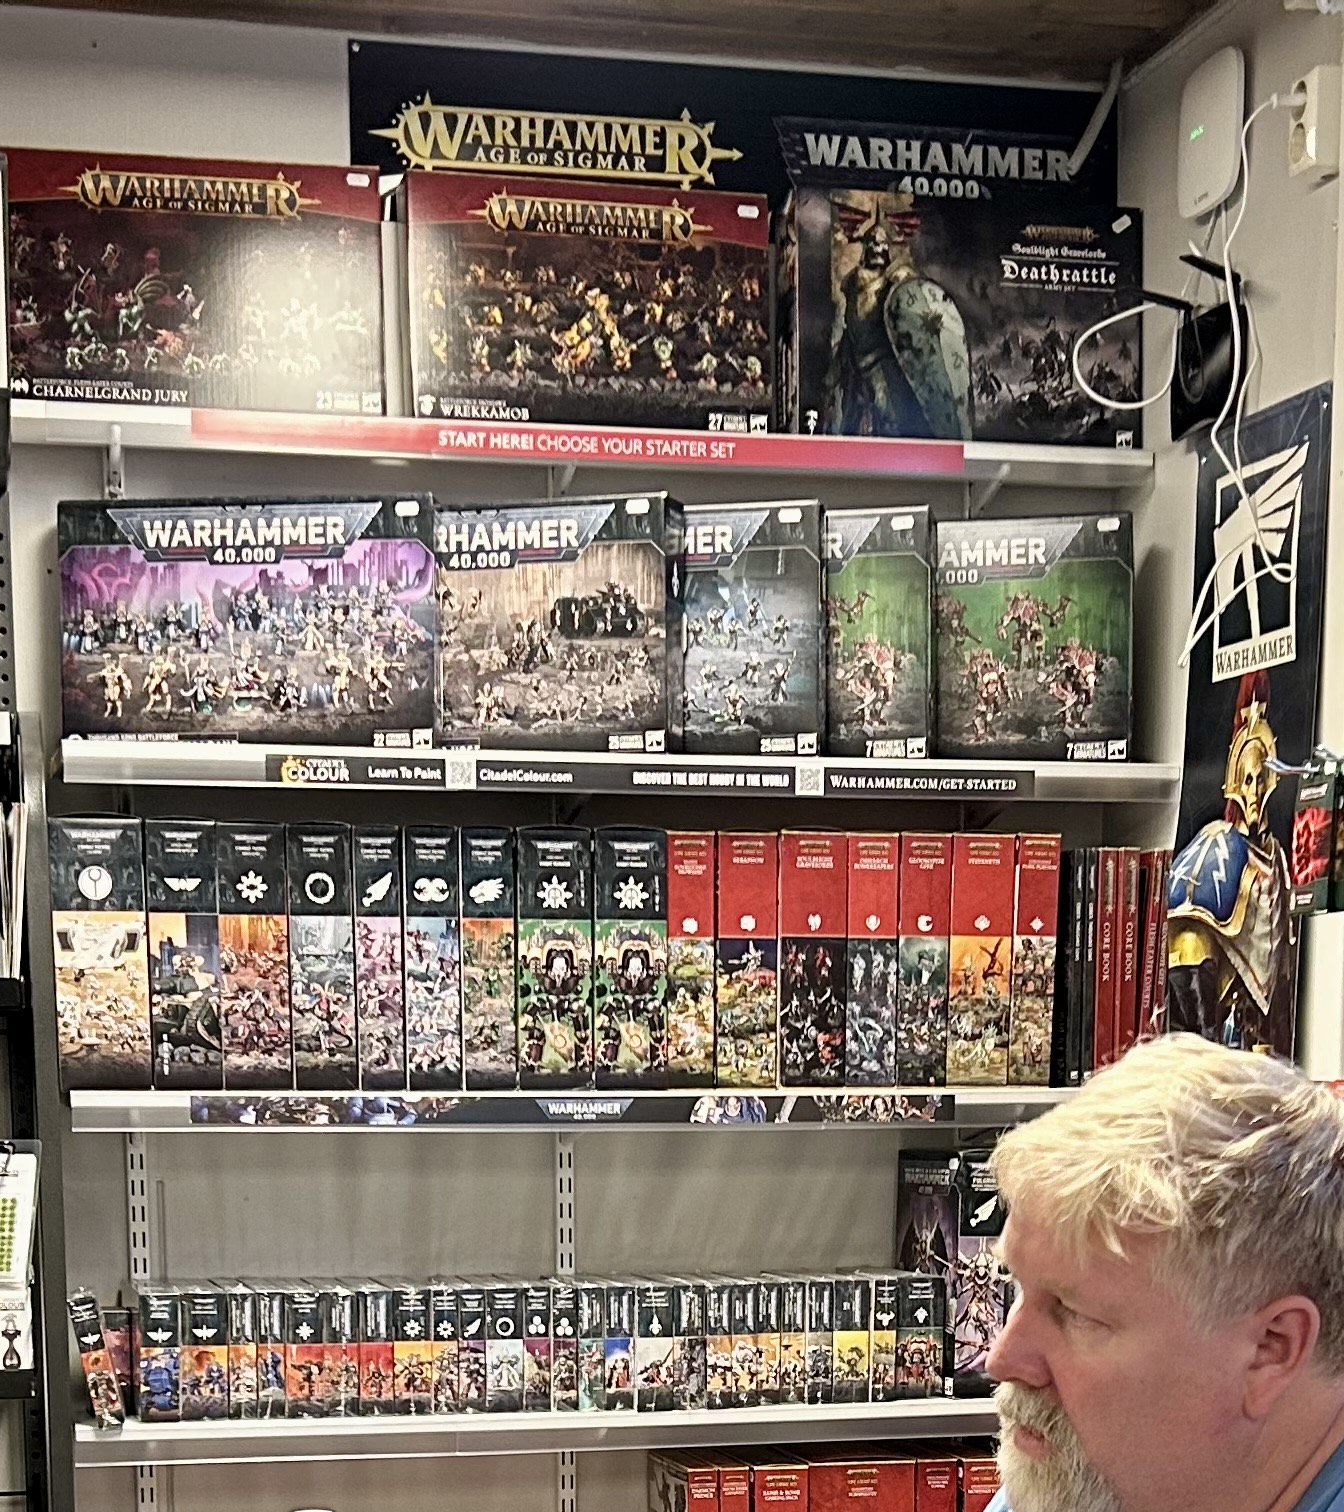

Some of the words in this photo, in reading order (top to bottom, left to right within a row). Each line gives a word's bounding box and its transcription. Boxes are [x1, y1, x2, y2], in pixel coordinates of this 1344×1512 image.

[406, 106, 702, 175] WARHAMMER
[474, 147, 521, 164] AGE
[554, 153, 647, 173] SIGMAR
[803, 132, 1071, 182] WARHAMMER
[84, 170, 296, 218] WARHAMMER
[489, 197, 686, 241] WARHAMMER
[1000, 258, 1117, 287] Deathrattle
[32, 384, 153, 403] CHARNELGRAND
[155, 389, 189, 404] JURY
[438, 431, 487, 448] START
[537, 433, 599, 454] CHOOSE
[601, 437, 643, 455] YOUR
[646, 438, 706, 457] STARTER
[709, 442, 736, 459] SET
[142, 514, 346, 549] WARHAMMER
[212, 545, 277, 567] 40,000
[449, 550, 511, 569] 40,000
[938, 536, 1047, 568] AMMER
[1215, 633, 1294, 675] WARHAMMER
[288, 765, 350, 783] COLOUR
[367, 766, 398, 780] Learn
[399, 767, 413, 780] To
[414, 768, 442, 782] Paint
[479, 769, 574, 785] CitadelColour.com
[1102, 952, 1111, 982] BOOK
[1125, 952, 1134, 982] BOOK
[548, 1101, 621, 1117] WARHAMMER
